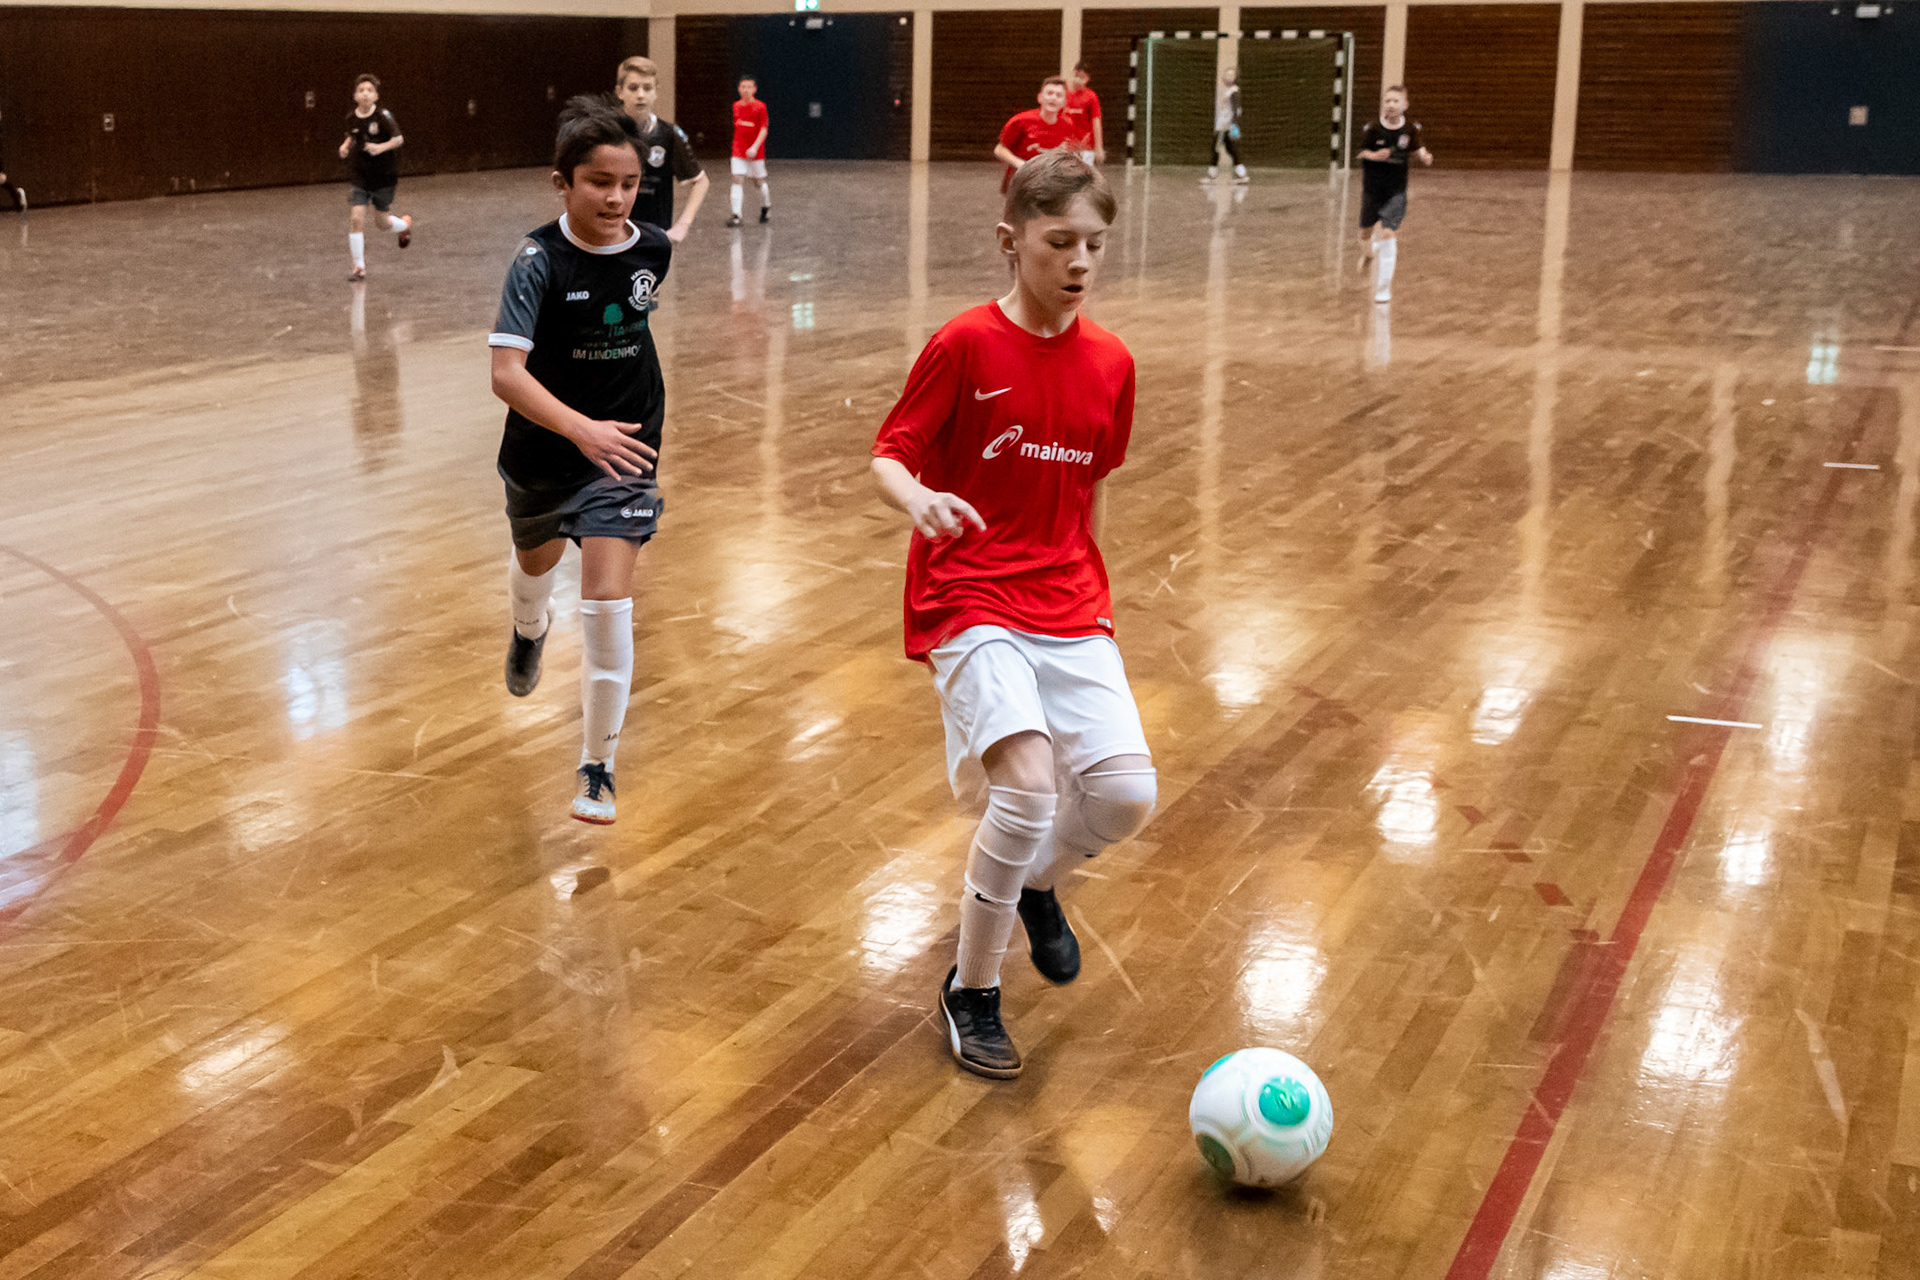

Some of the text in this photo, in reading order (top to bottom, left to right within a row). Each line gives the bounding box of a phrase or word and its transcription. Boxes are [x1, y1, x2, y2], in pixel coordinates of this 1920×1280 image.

[566, 290, 590, 301] JAKO
[588, 345, 642, 360] LINDENHO
[1020, 441, 1093, 465] mainova
[632, 508, 654, 517] JAKO
